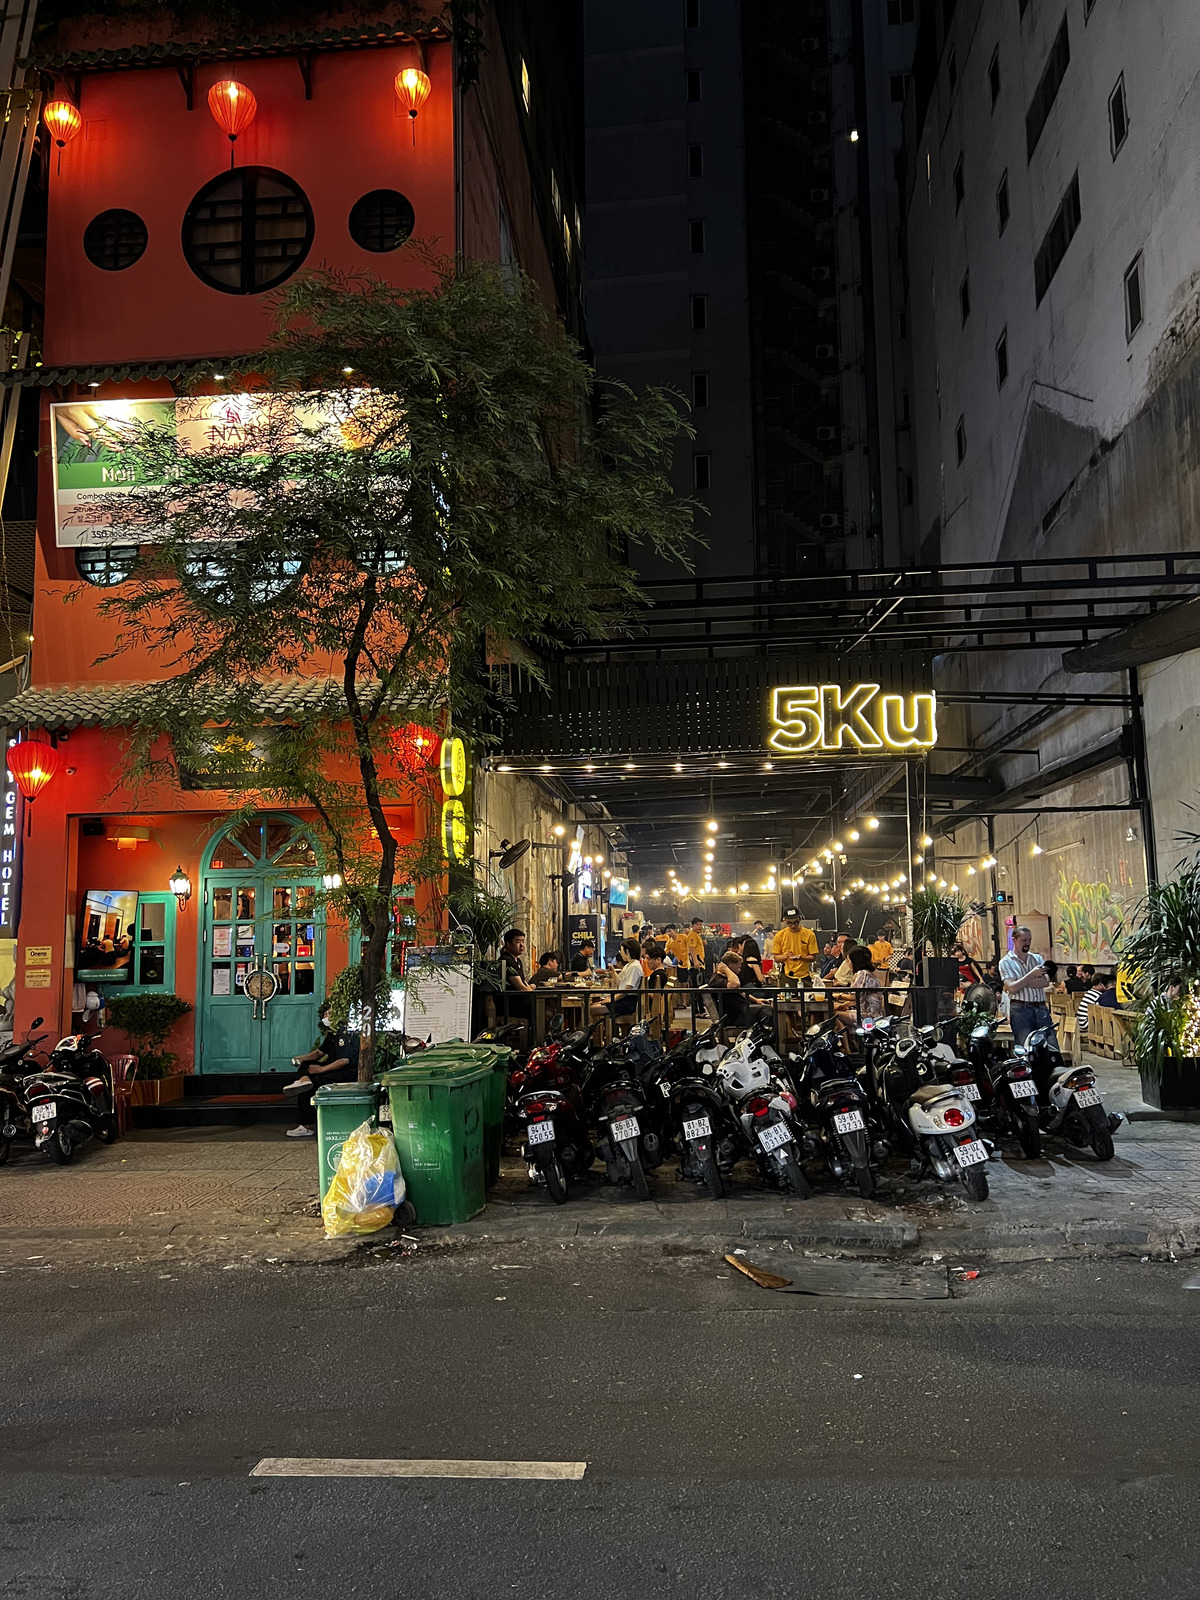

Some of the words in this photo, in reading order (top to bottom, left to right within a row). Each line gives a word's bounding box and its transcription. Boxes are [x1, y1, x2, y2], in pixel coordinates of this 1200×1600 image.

[769, 683, 938, 751] 5Ku
[6, 738, 17, 783] SY
[4, 791, 16, 836] GEM
[1, 849, 13, 925] HOTEL
[572, 931, 595, 939] CHILL
